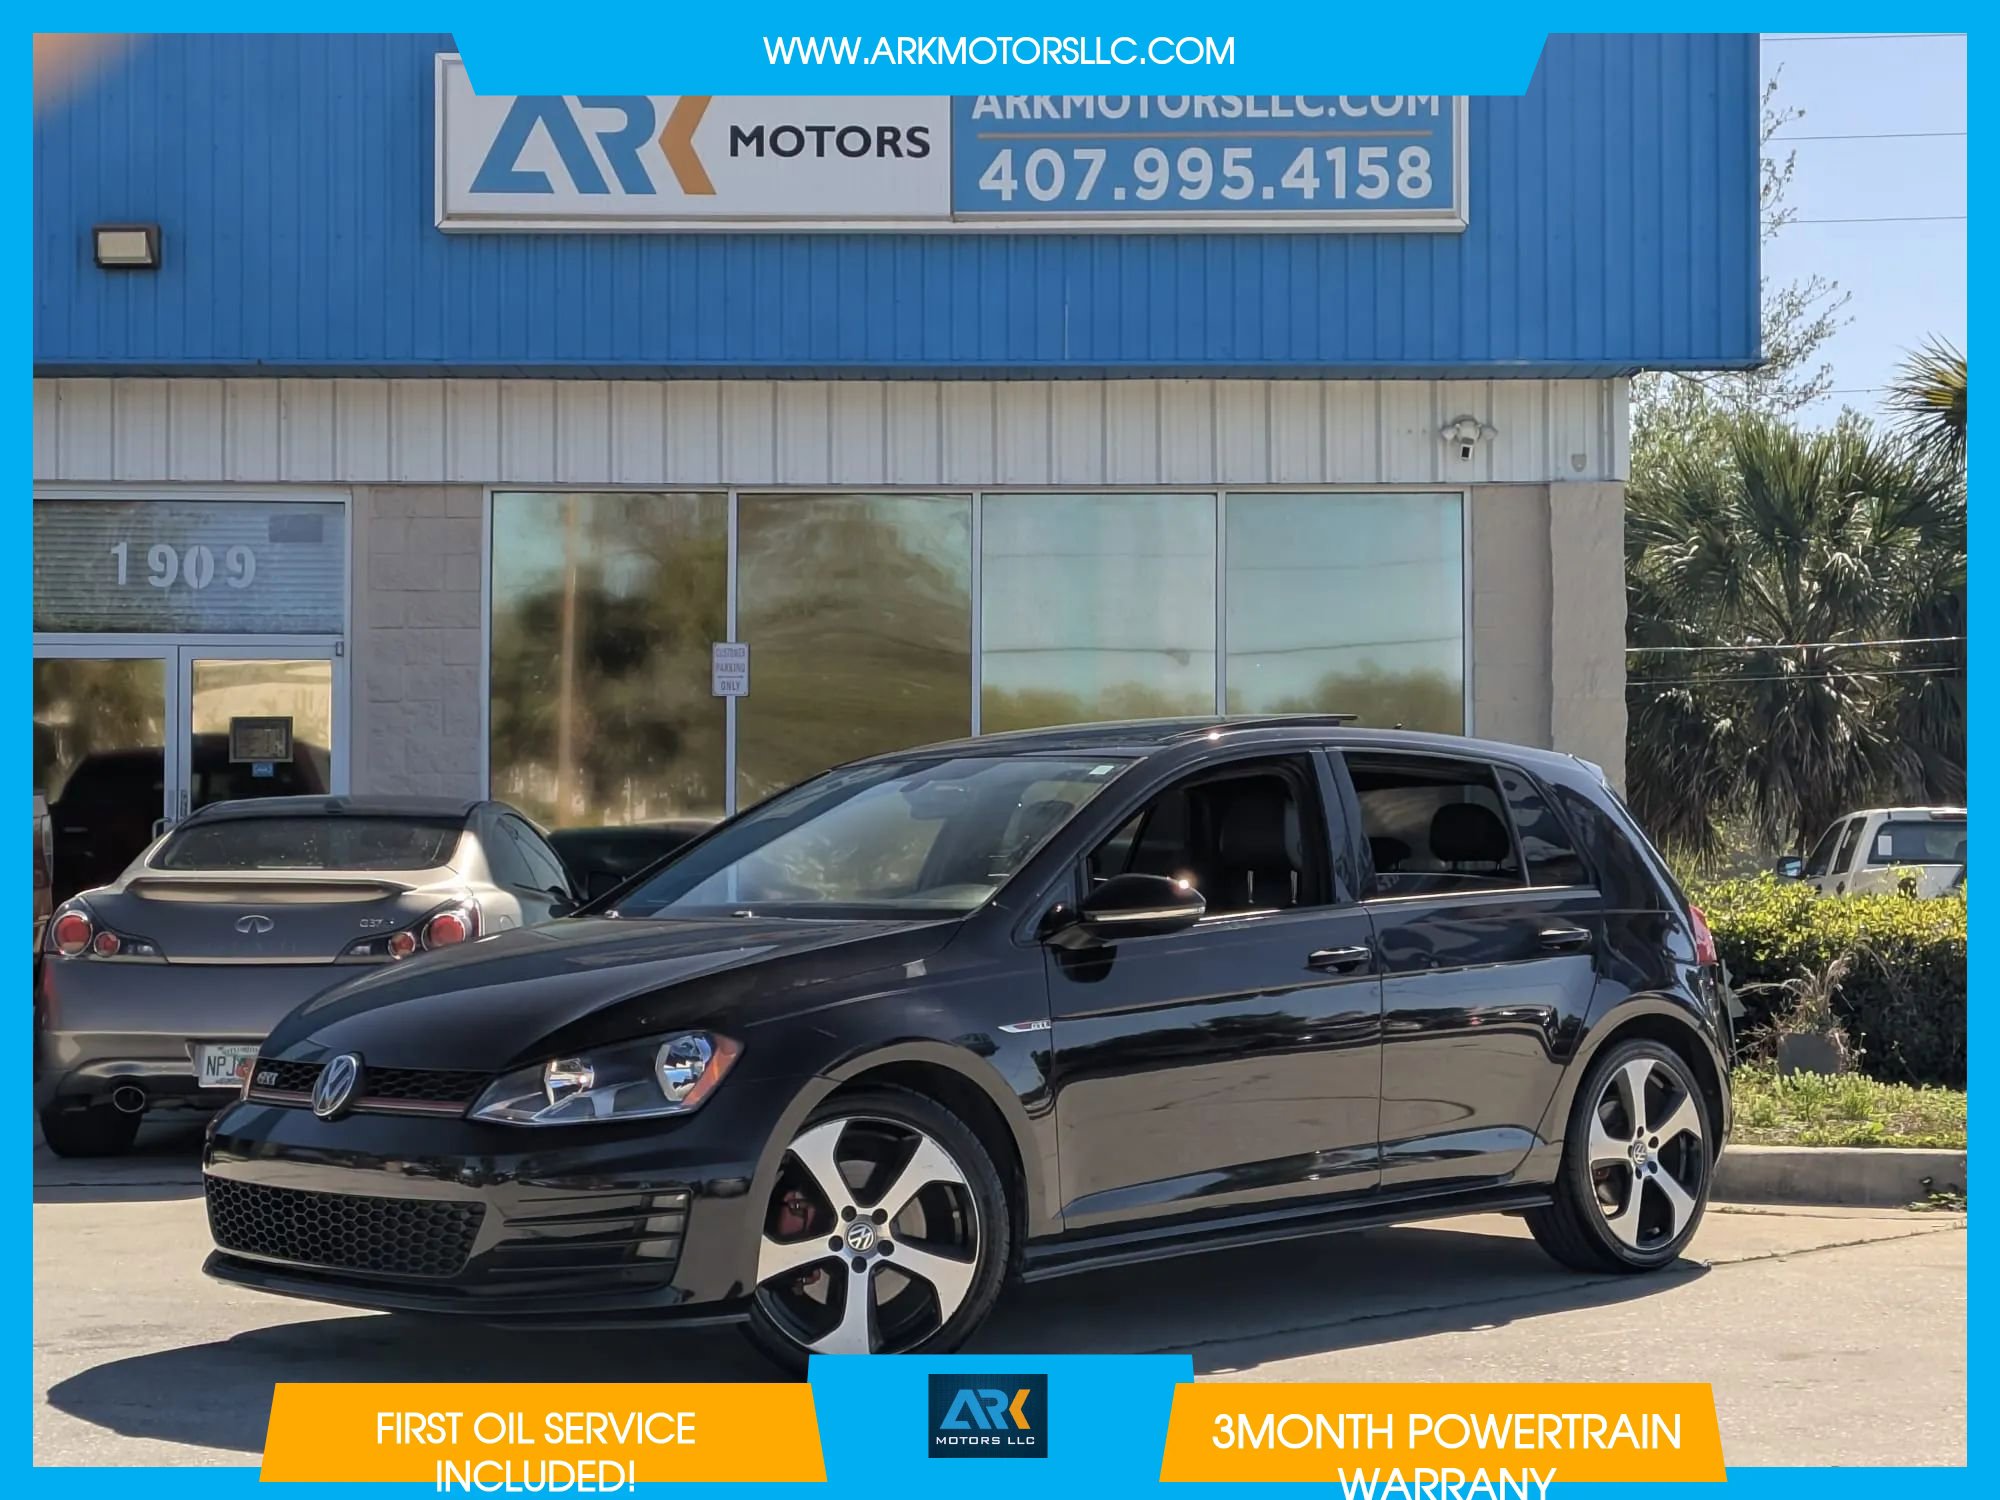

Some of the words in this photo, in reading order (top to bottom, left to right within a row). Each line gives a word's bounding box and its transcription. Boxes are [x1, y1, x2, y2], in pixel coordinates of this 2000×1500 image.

[469, 95, 717, 195] ARK
[729, 124, 931, 159] MOTORS
[978, 145, 1434, 202] 407.995.4158
[111, 541, 257, 590] 1909
[720, 680, 741, 691] ONLY
